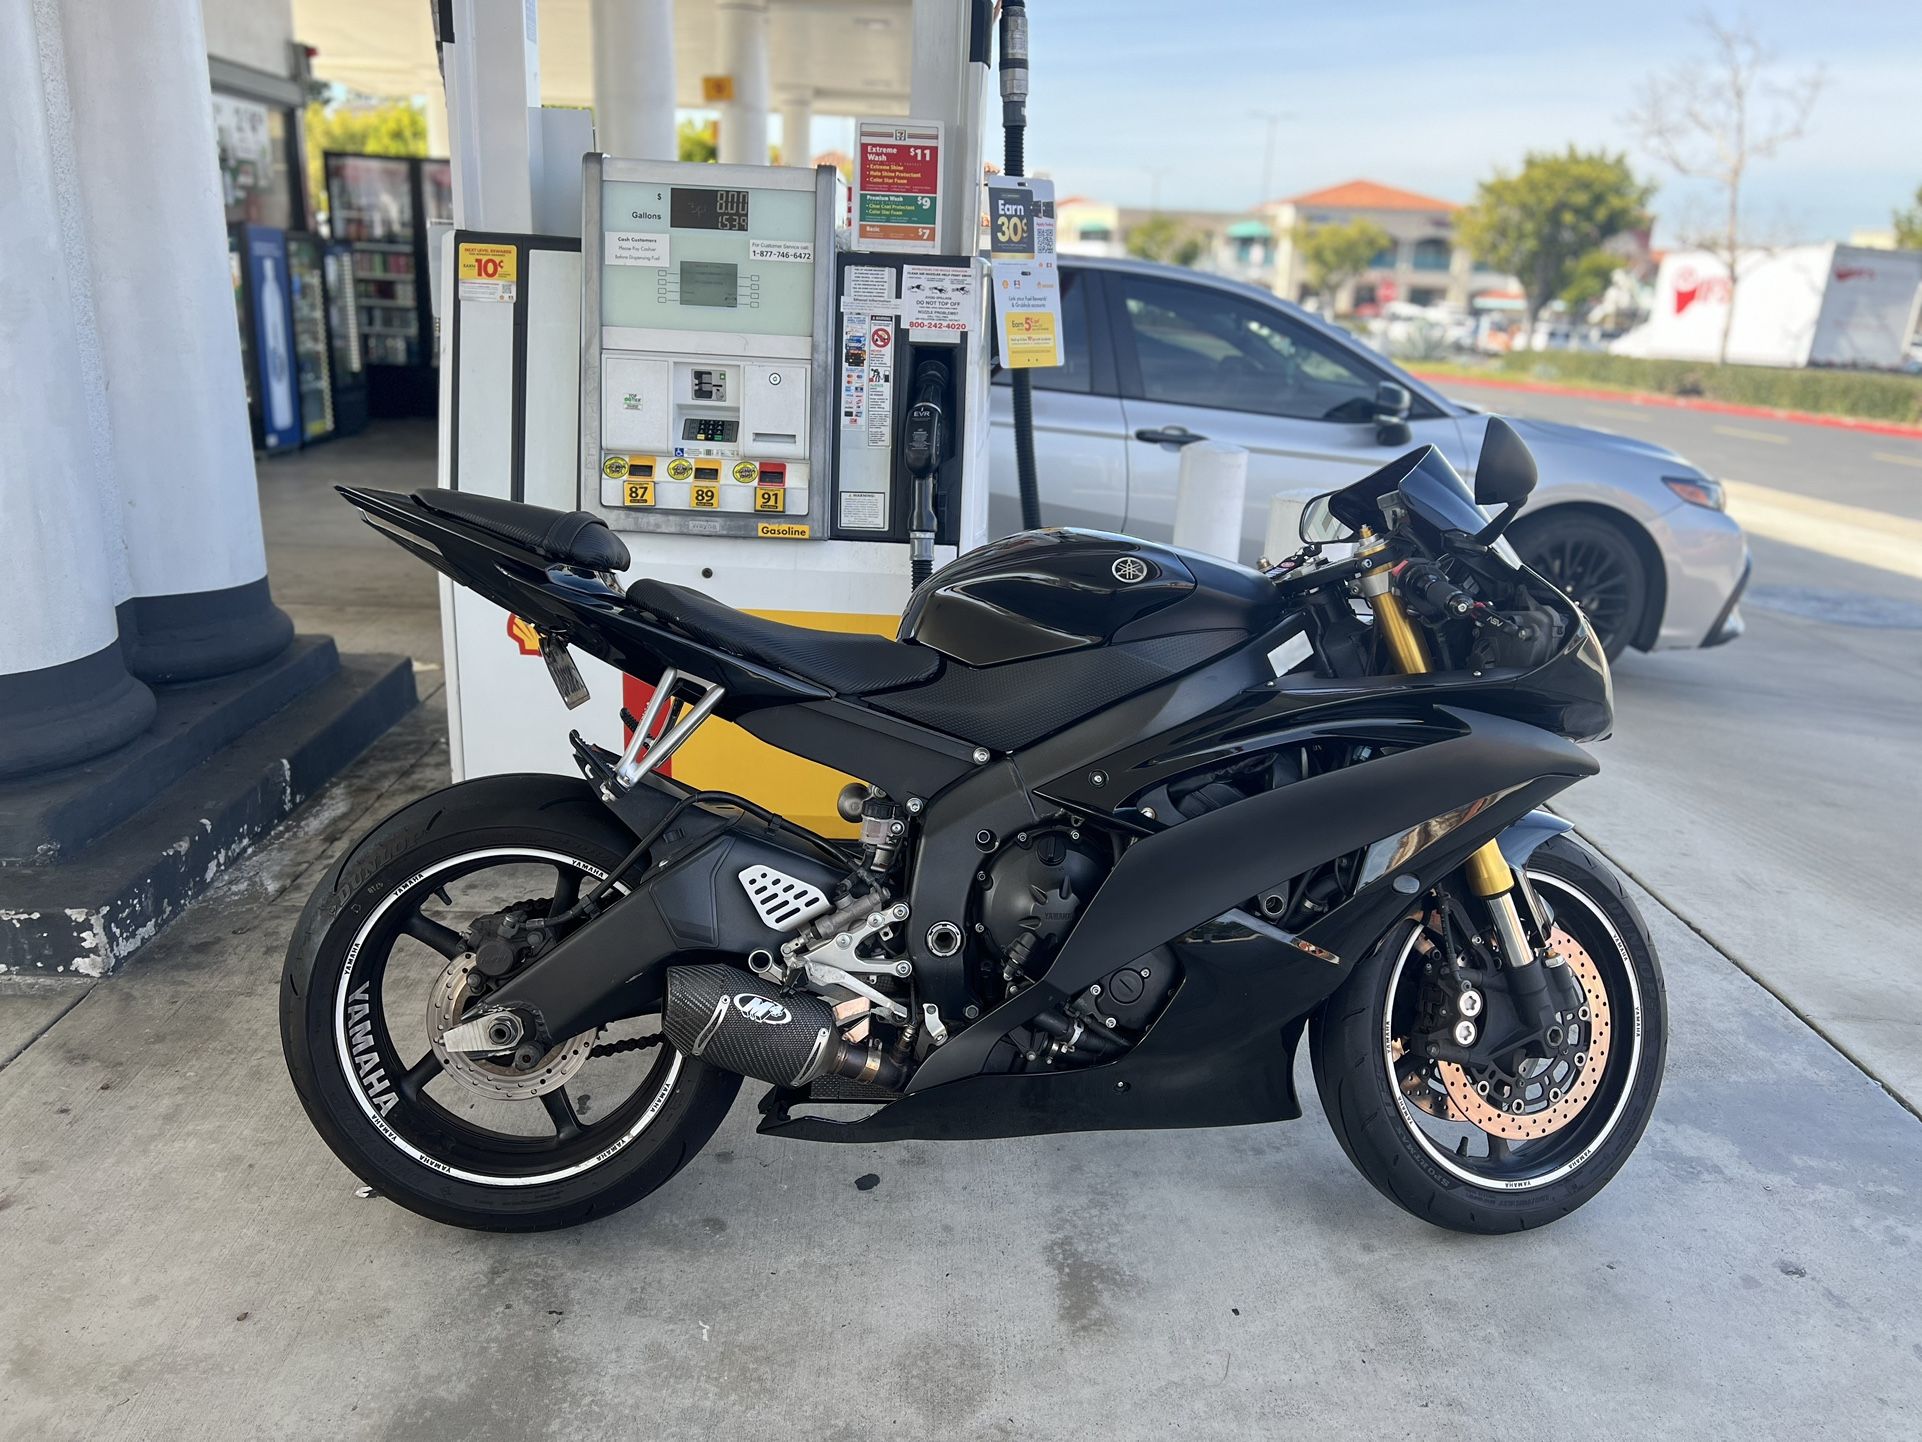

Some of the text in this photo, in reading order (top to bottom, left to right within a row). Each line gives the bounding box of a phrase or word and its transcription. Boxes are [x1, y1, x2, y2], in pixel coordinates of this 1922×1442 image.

[868, 146, 898, 154] Extreme
[909, 147, 931, 161] $11
[657, 193, 662, 201] $
[917, 196, 932, 210] $9
[998, 200, 1025, 216] Earn
[631, 211, 662, 220] Gallons
[918, 228, 931, 240] $7
[752, 250, 812, 260] 1-877-746-6472
[909, 321, 967, 330] 800-242-4020
[1012, 320, 1024, 328] Earn
[629, 486, 649, 499] 87
[695, 489, 714, 502] 89
[761, 492, 779, 505] 91
[761, 526, 806, 537] Gasoline
[572, 860, 604, 878] YAMAHA
[393, 873, 424, 897] YAMAHA
[344, 943, 361, 976] YAMAHA
[348, 980, 400, 1118] YAMAHA
[650, 1083, 671, 1113] YAMAHA
[371, 1114, 398, 1142] YAMAHA
[596, 1139, 627, 1162] YAMAHA
[419, 1154, 452, 1174] YAMAHA
